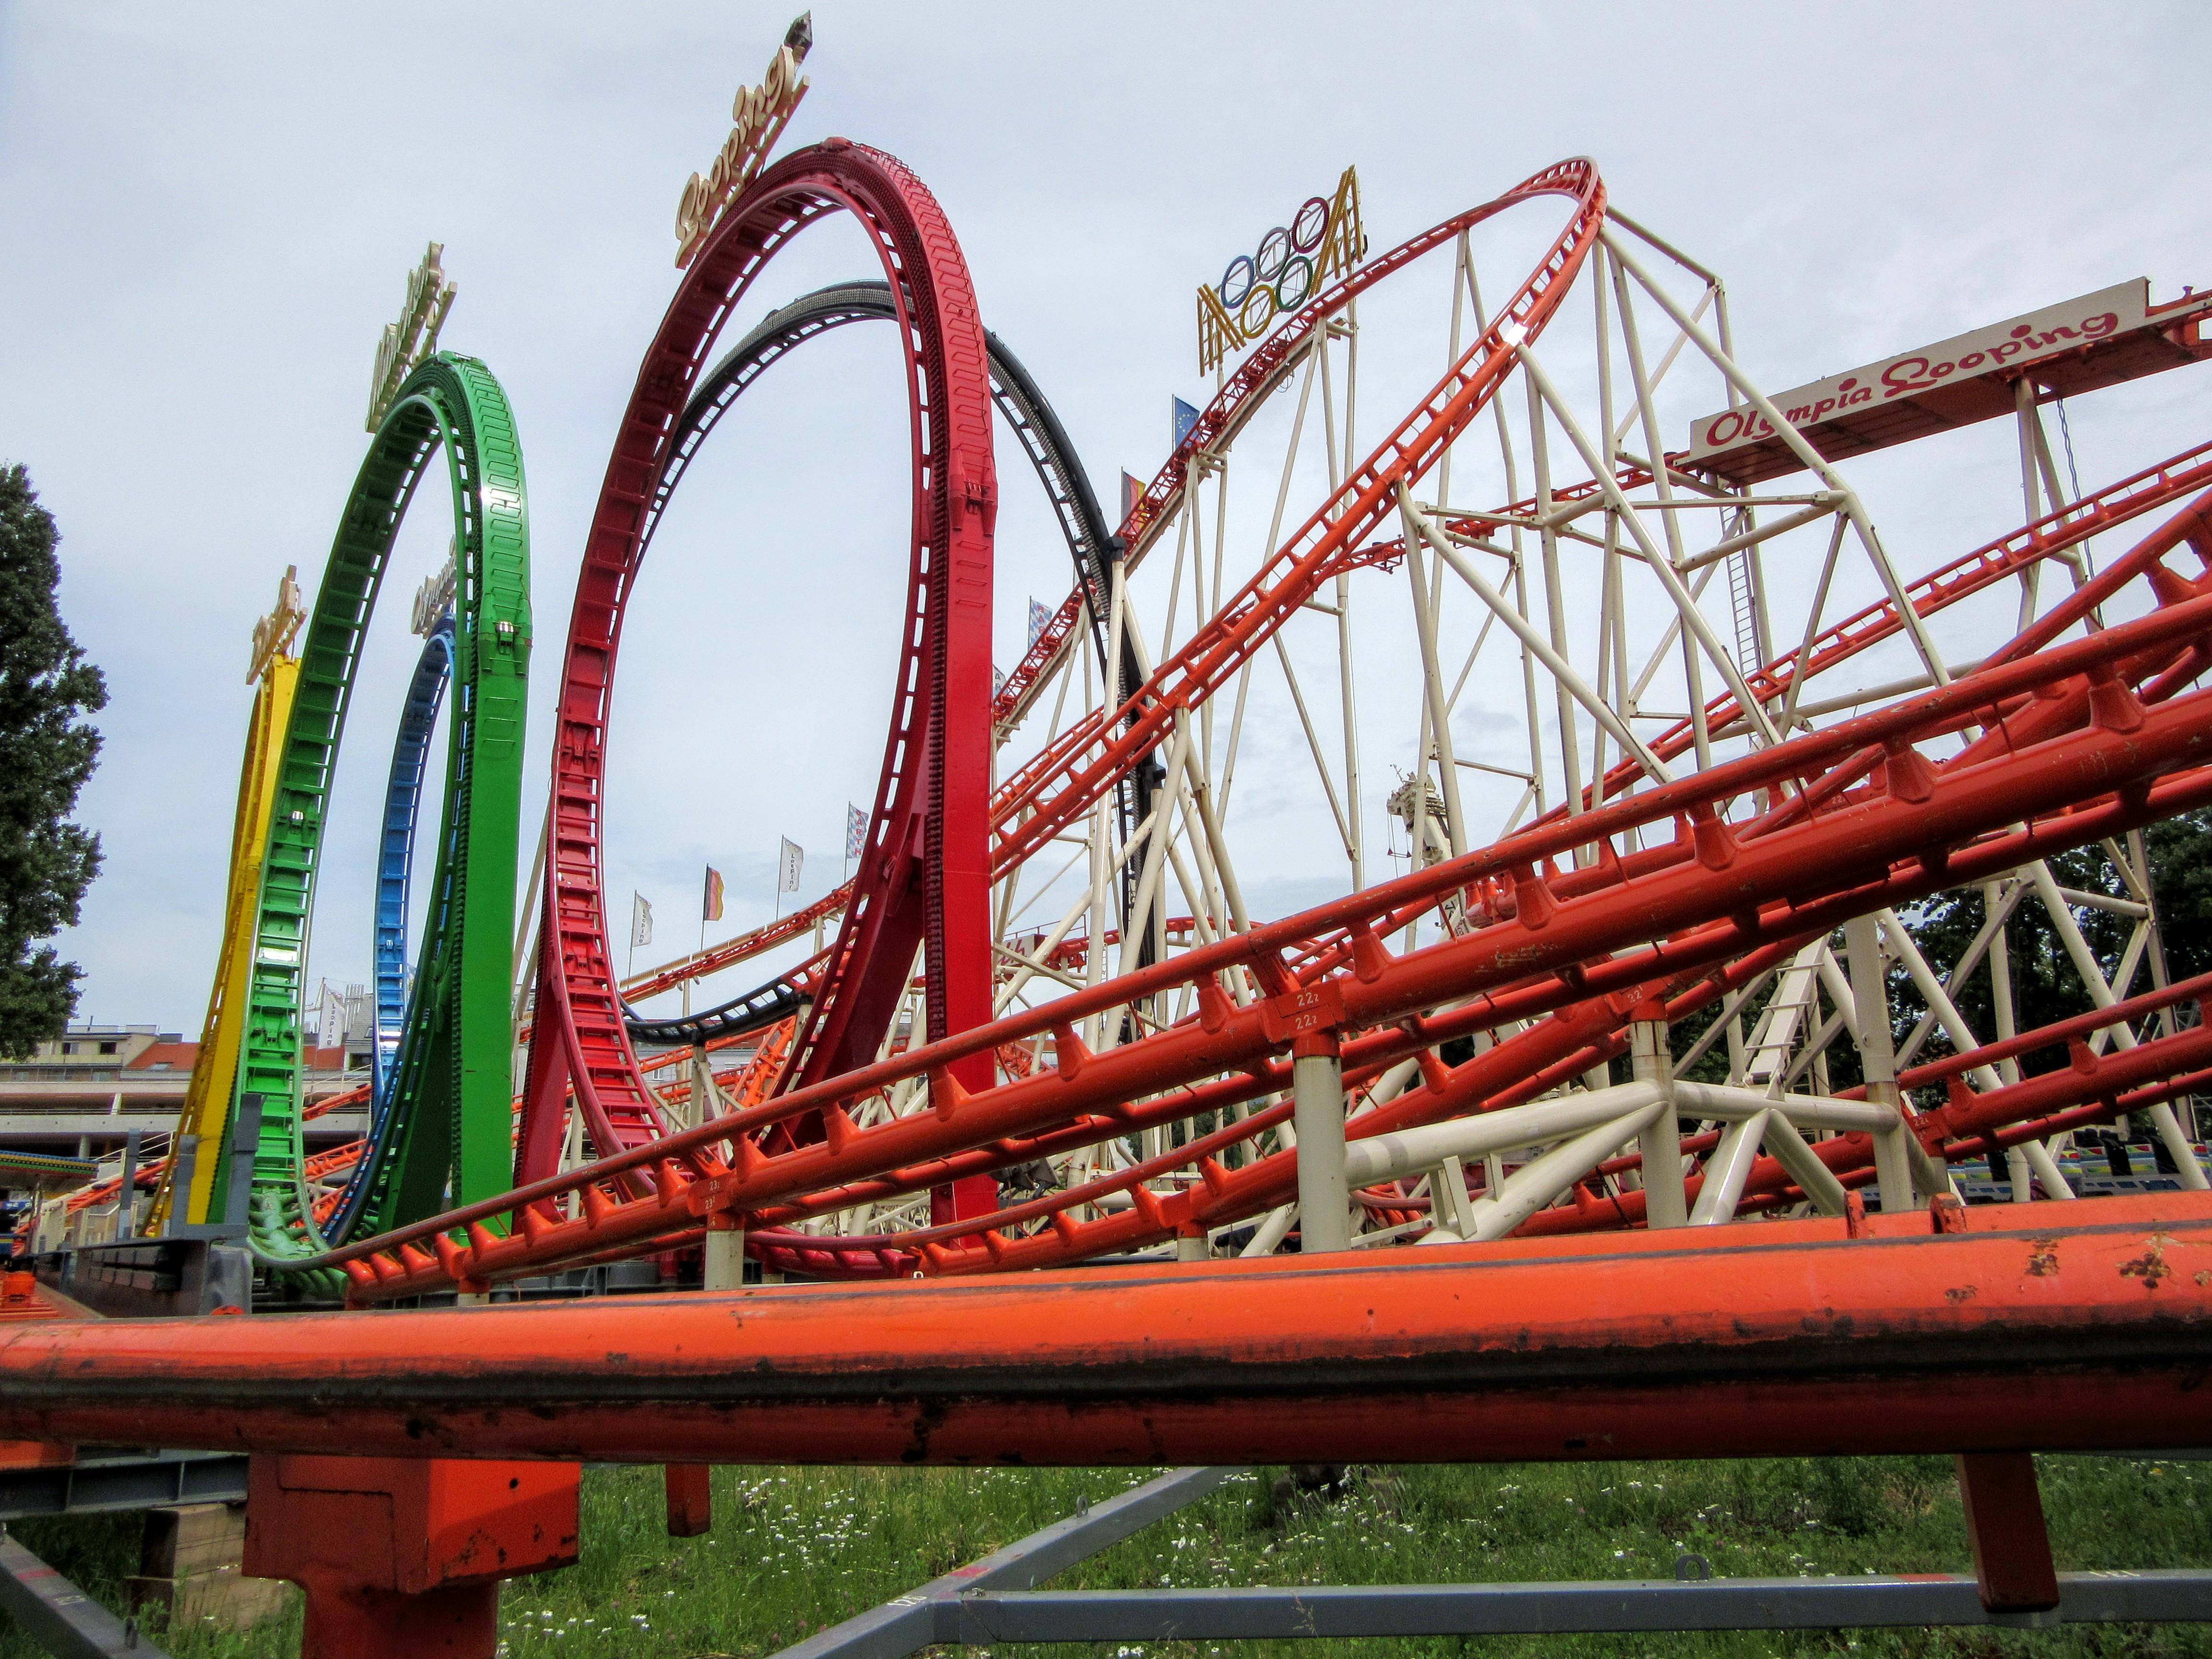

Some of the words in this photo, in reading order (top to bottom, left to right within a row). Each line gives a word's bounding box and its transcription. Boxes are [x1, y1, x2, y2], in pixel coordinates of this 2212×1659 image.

[1706, 377, 1873, 446] Olympia
[1881, 312, 2119, 398] Looping
[327, 1003, 336, 1046] Looping
[1295, 1014, 1318, 1030] 222
